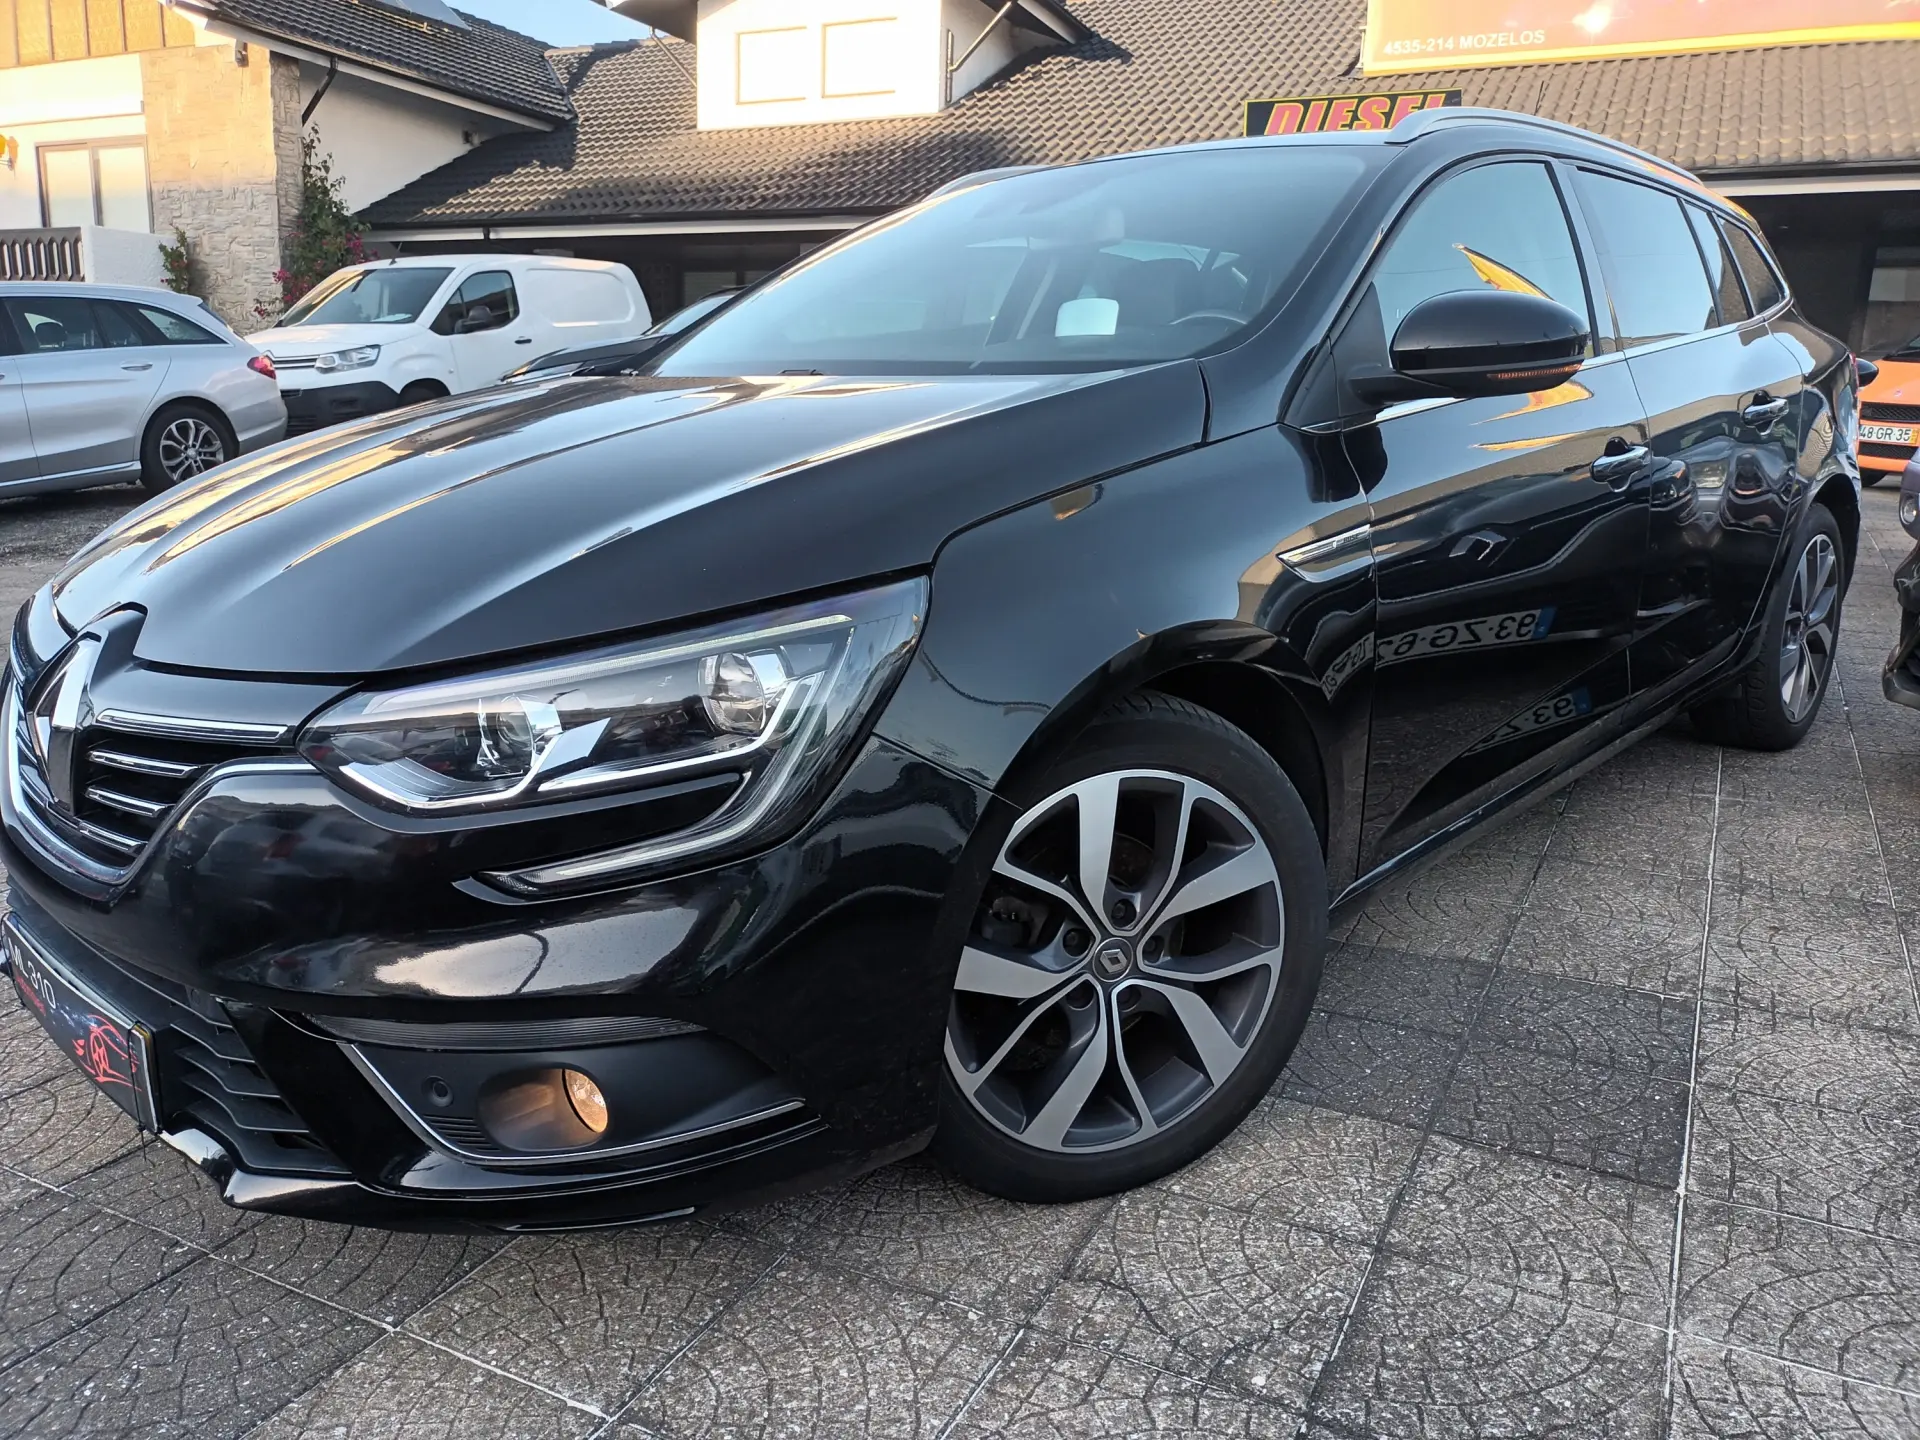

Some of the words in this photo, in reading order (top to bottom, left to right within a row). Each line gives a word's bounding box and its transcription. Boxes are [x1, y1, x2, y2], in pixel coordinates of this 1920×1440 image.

[1383, 35, 1455, 56] 4535-214
[1459, 29, 1546, 50] MOZELOS
[1264, 93, 1446, 136] DIESE
